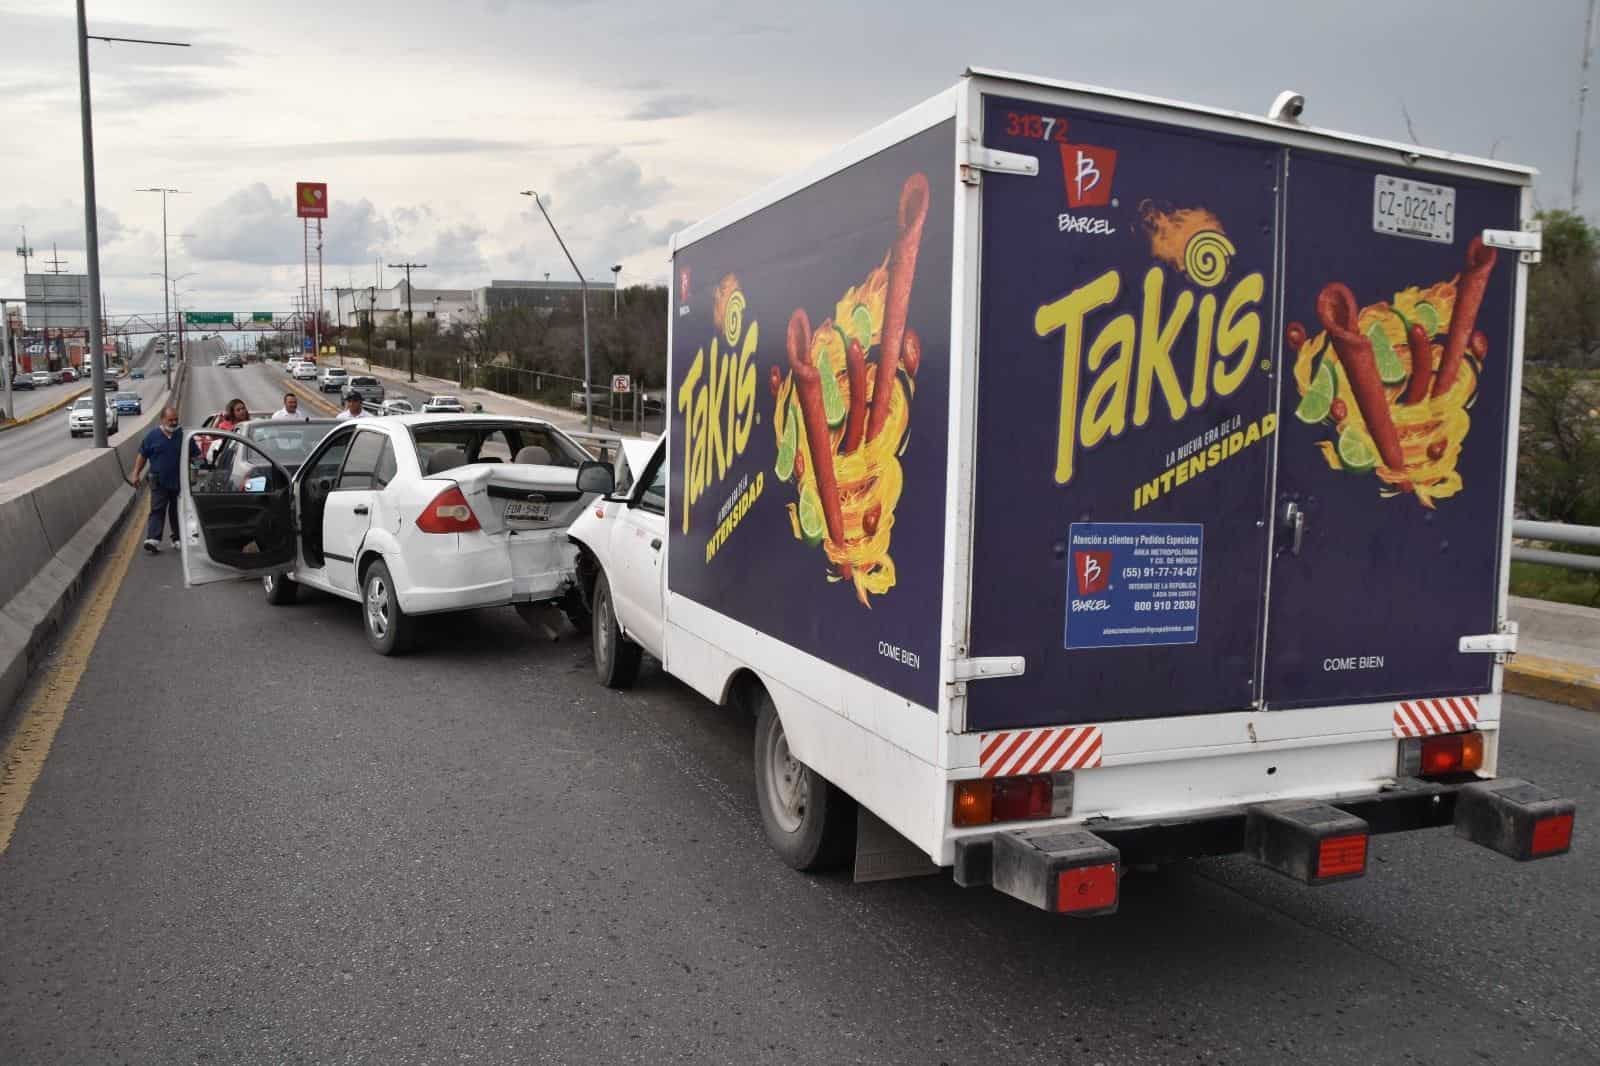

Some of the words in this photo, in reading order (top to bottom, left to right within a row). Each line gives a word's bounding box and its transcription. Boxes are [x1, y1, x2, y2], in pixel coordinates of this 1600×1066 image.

[1007, 112, 1070, 143] 31372
[1058, 213, 1115, 235] BARCEL
[1165, 451, 1175, 467] LA
[1177, 436, 1202, 460] NUEVA
[1204, 426, 1219, 446] ERA
[1220, 419, 1231, 436] DE
[1232, 414, 1241, 430] LA
[1133, 413, 1277, 511] INTENSIDAD
[706, 471, 764, 565] INTENSIDAD
[1122, 567, 1142, 579] (55)
[1144, 567, 1197, 577] 91-77-74-07
[1072, 599, 1111, 613] BARCEL
[1154, 601, 1171, 610] 910
[879, 641, 900, 661] COME
[901, 649, 920, 670] BIEN
[1323, 657, 1358, 671] COME
[1359, 655, 1385, 669] BIEN
